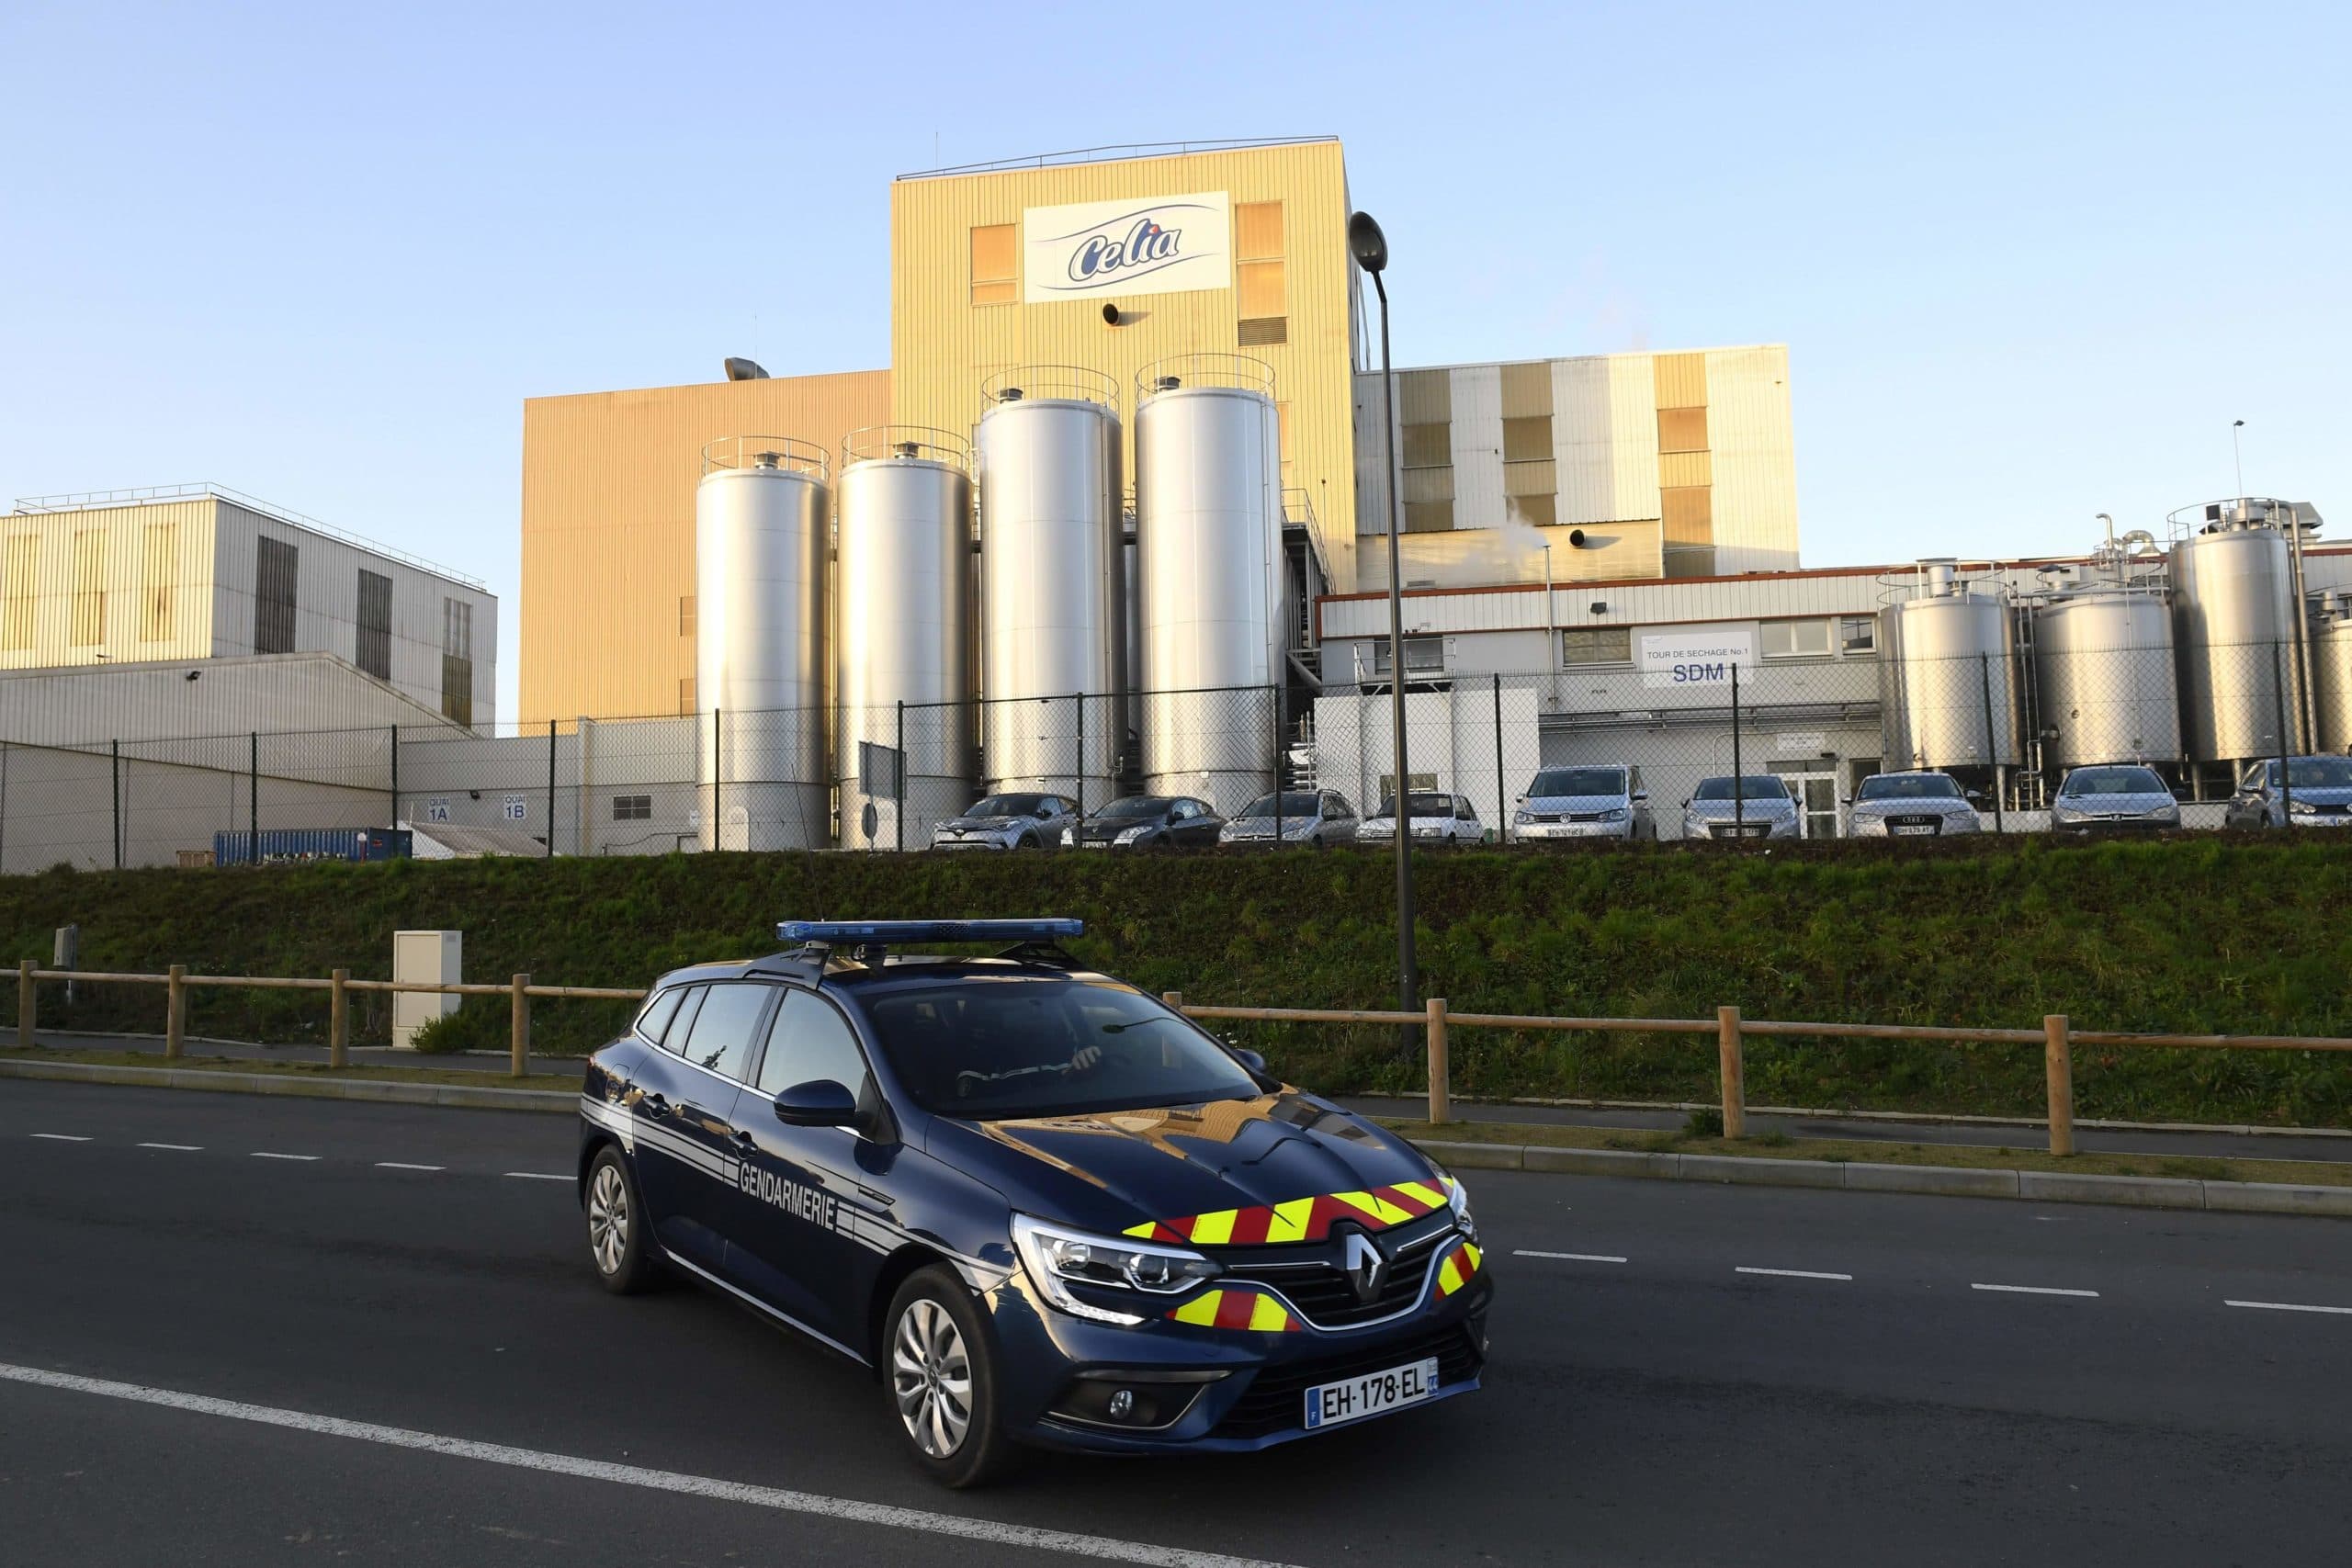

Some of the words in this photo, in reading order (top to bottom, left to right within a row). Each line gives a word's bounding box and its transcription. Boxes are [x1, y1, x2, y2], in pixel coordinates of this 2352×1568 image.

[1068, 217, 1182, 282] Celia
[1647, 650, 1671, 660] TOUR
[1672, 649, 1685, 659] DE
[1687, 649, 1727, 657] SECHAGE
[1673, 662, 1724, 682] SDM
[504, 795, 526, 804] QUAI
[429, 807, 447, 821] 1A
[505, 805, 525, 818] 1B
[740, 1161, 836, 1232] GENDARMERIE
[1323, 1367, 1426, 1419] EH-178-EL
